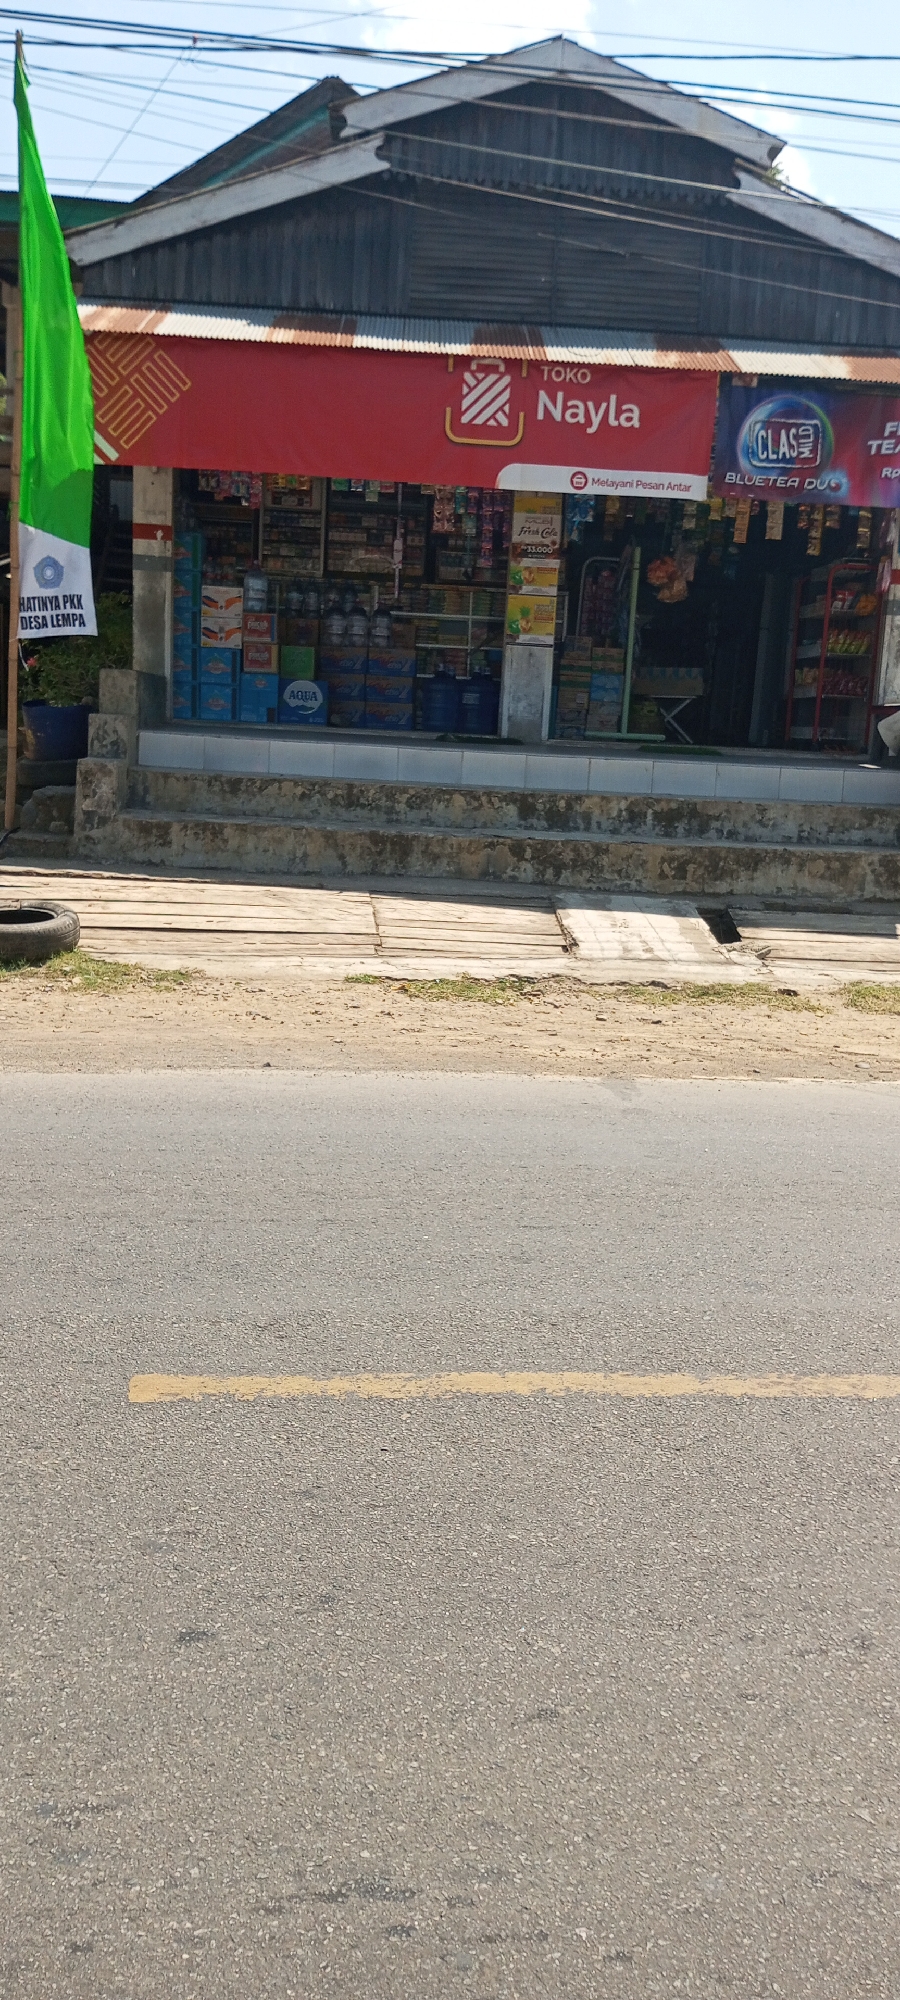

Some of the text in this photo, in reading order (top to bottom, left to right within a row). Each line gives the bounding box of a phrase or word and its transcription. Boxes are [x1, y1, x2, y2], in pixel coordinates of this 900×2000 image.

[540, 365, 592, 385] TOKO
[536, 389, 641, 434] Nayla
[757, 427, 798, 460] CLAS
[798, 425, 814, 458] MILD
[591, 477, 692, 493] Melayani Pesan Antar
[724, 472, 800, 488] BLUETEA
[19, 594, 83, 613] HATINYA PKK
[20, 613, 86, 631] DESA LEMPA
[288, 690, 318, 703] AQUA
